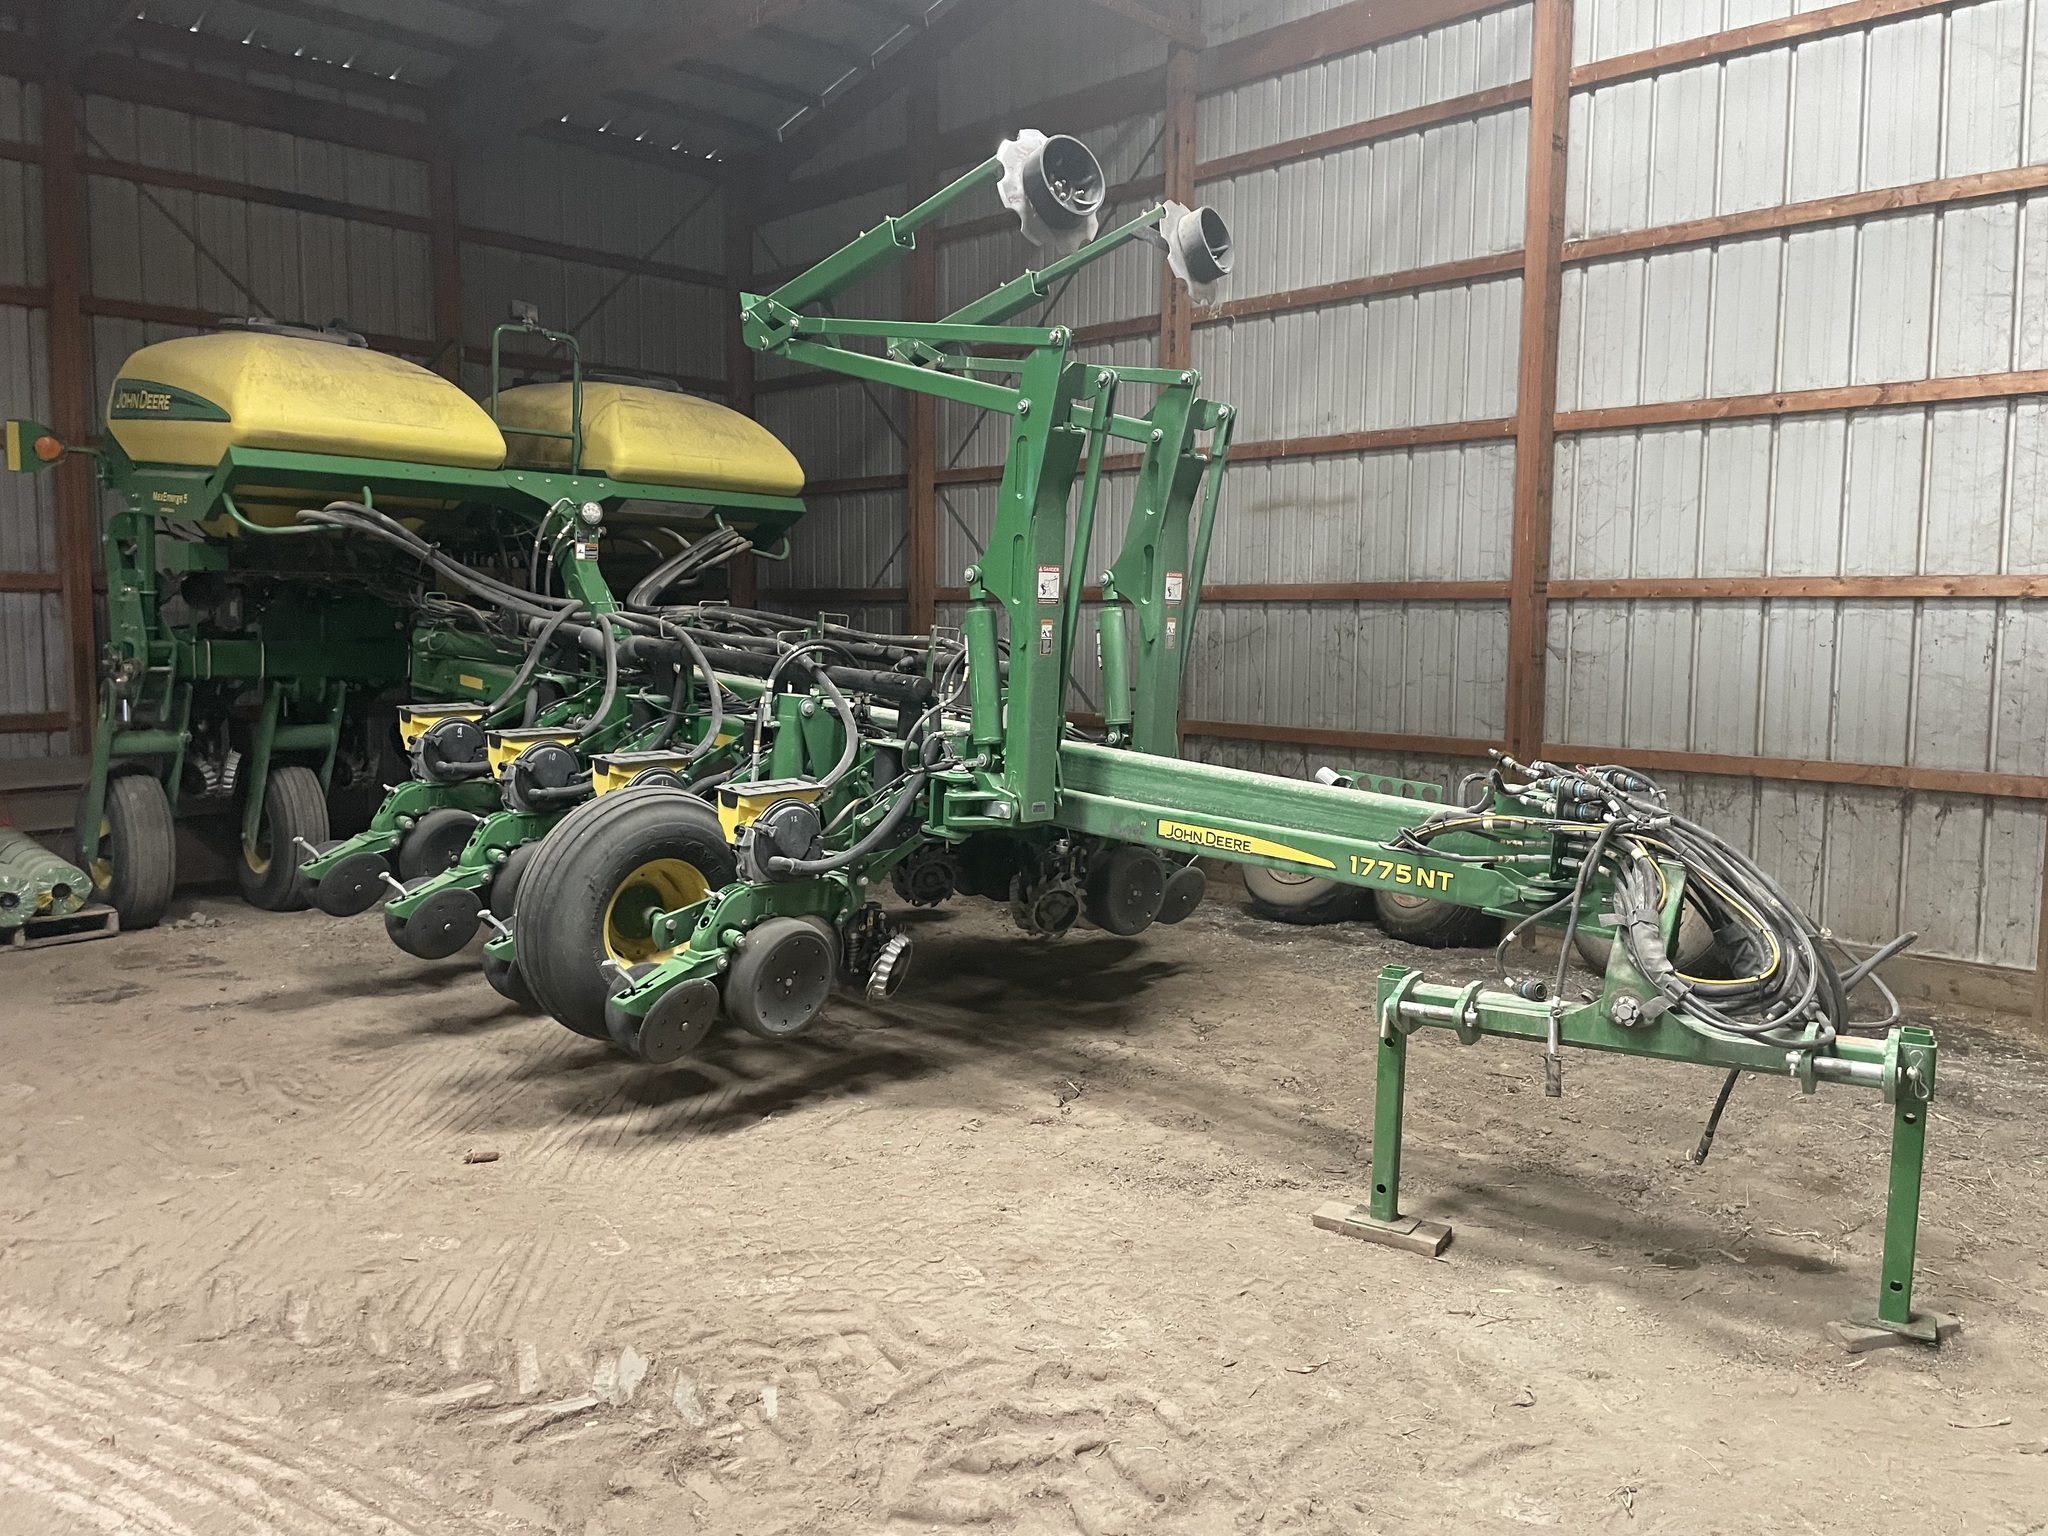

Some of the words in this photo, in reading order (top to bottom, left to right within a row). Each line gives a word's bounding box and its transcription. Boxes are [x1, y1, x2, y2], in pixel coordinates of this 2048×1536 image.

[116, 389, 140, 409] JOHN
[140, 390, 171, 411] DEERE
[1166, 825, 1203, 843] JOHN
[1205, 831, 1252, 852] DEERE
